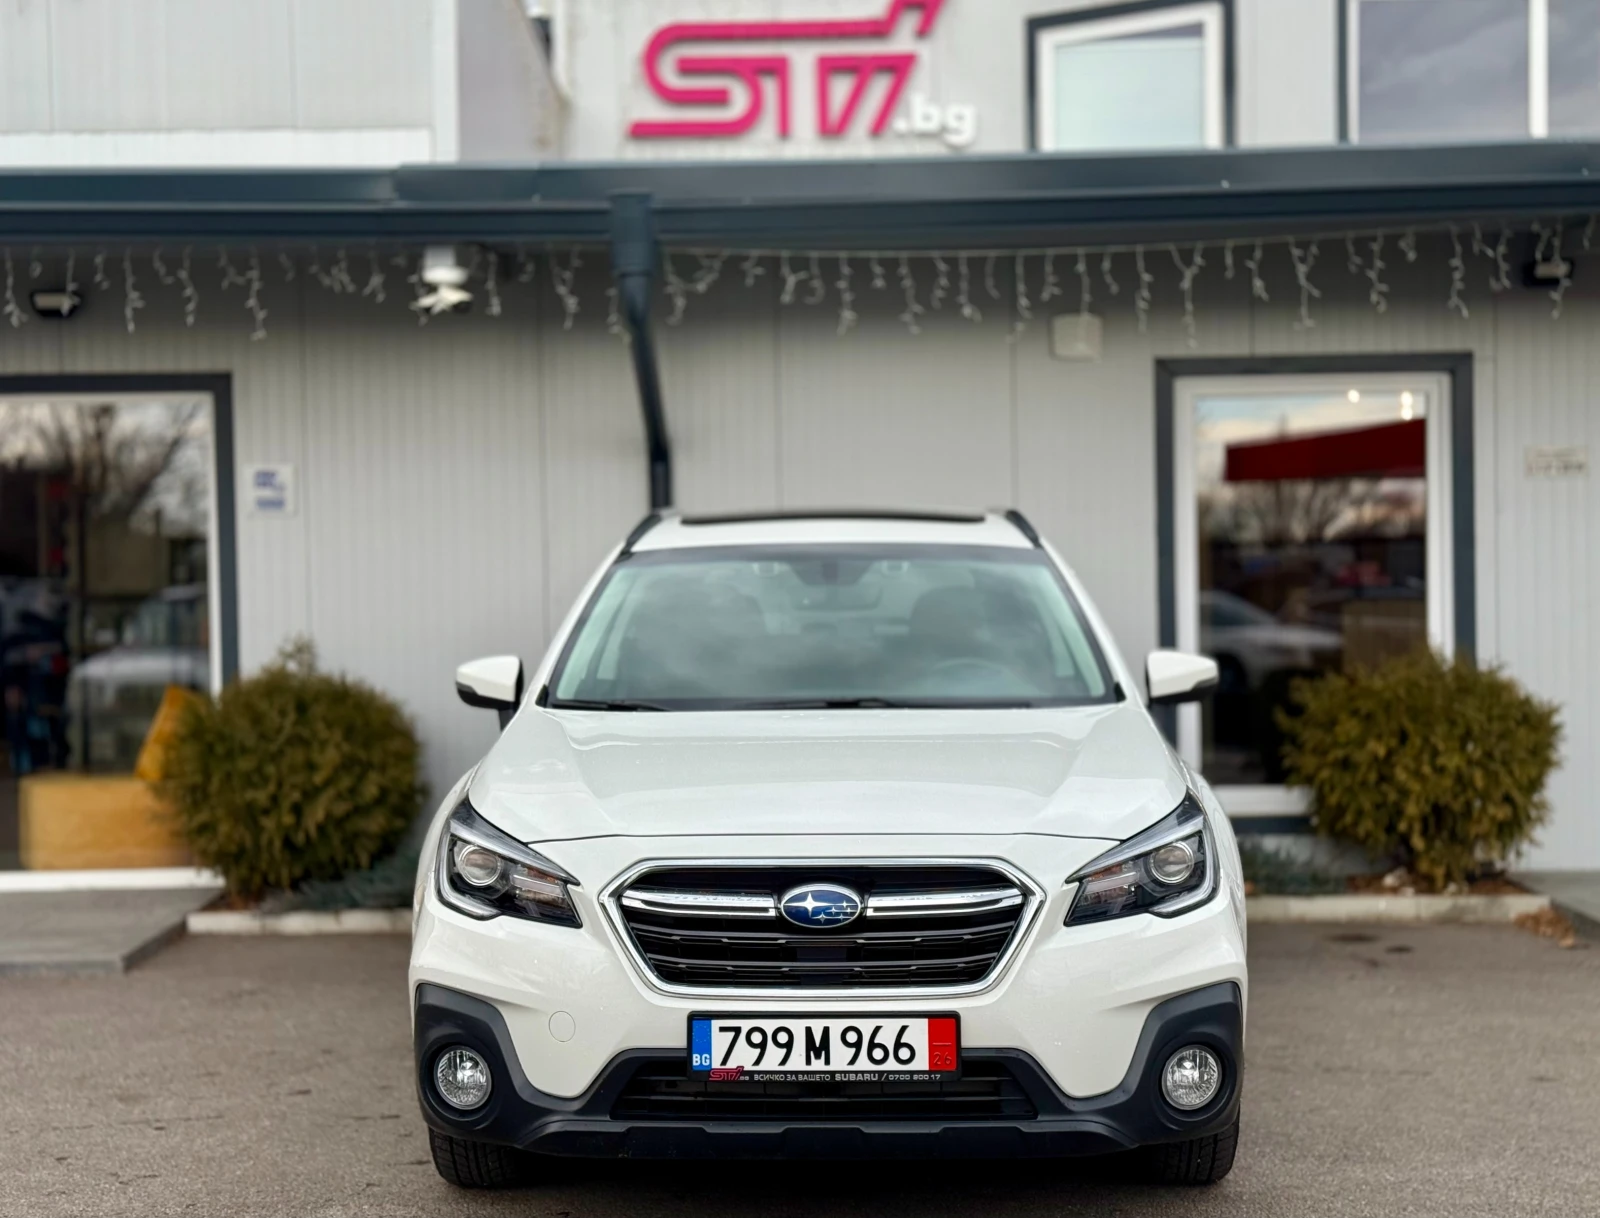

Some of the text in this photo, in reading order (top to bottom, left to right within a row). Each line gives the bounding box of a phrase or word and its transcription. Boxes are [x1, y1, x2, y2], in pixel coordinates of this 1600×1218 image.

[719, 1025, 916, 1066] 799 M 966
[692, 1054, 710, 1066] BG
[933, 1051, 952, 1065] 26
[835, 1073, 878, 1081] SUBARU
[881, 1073, 888, 1081] /
